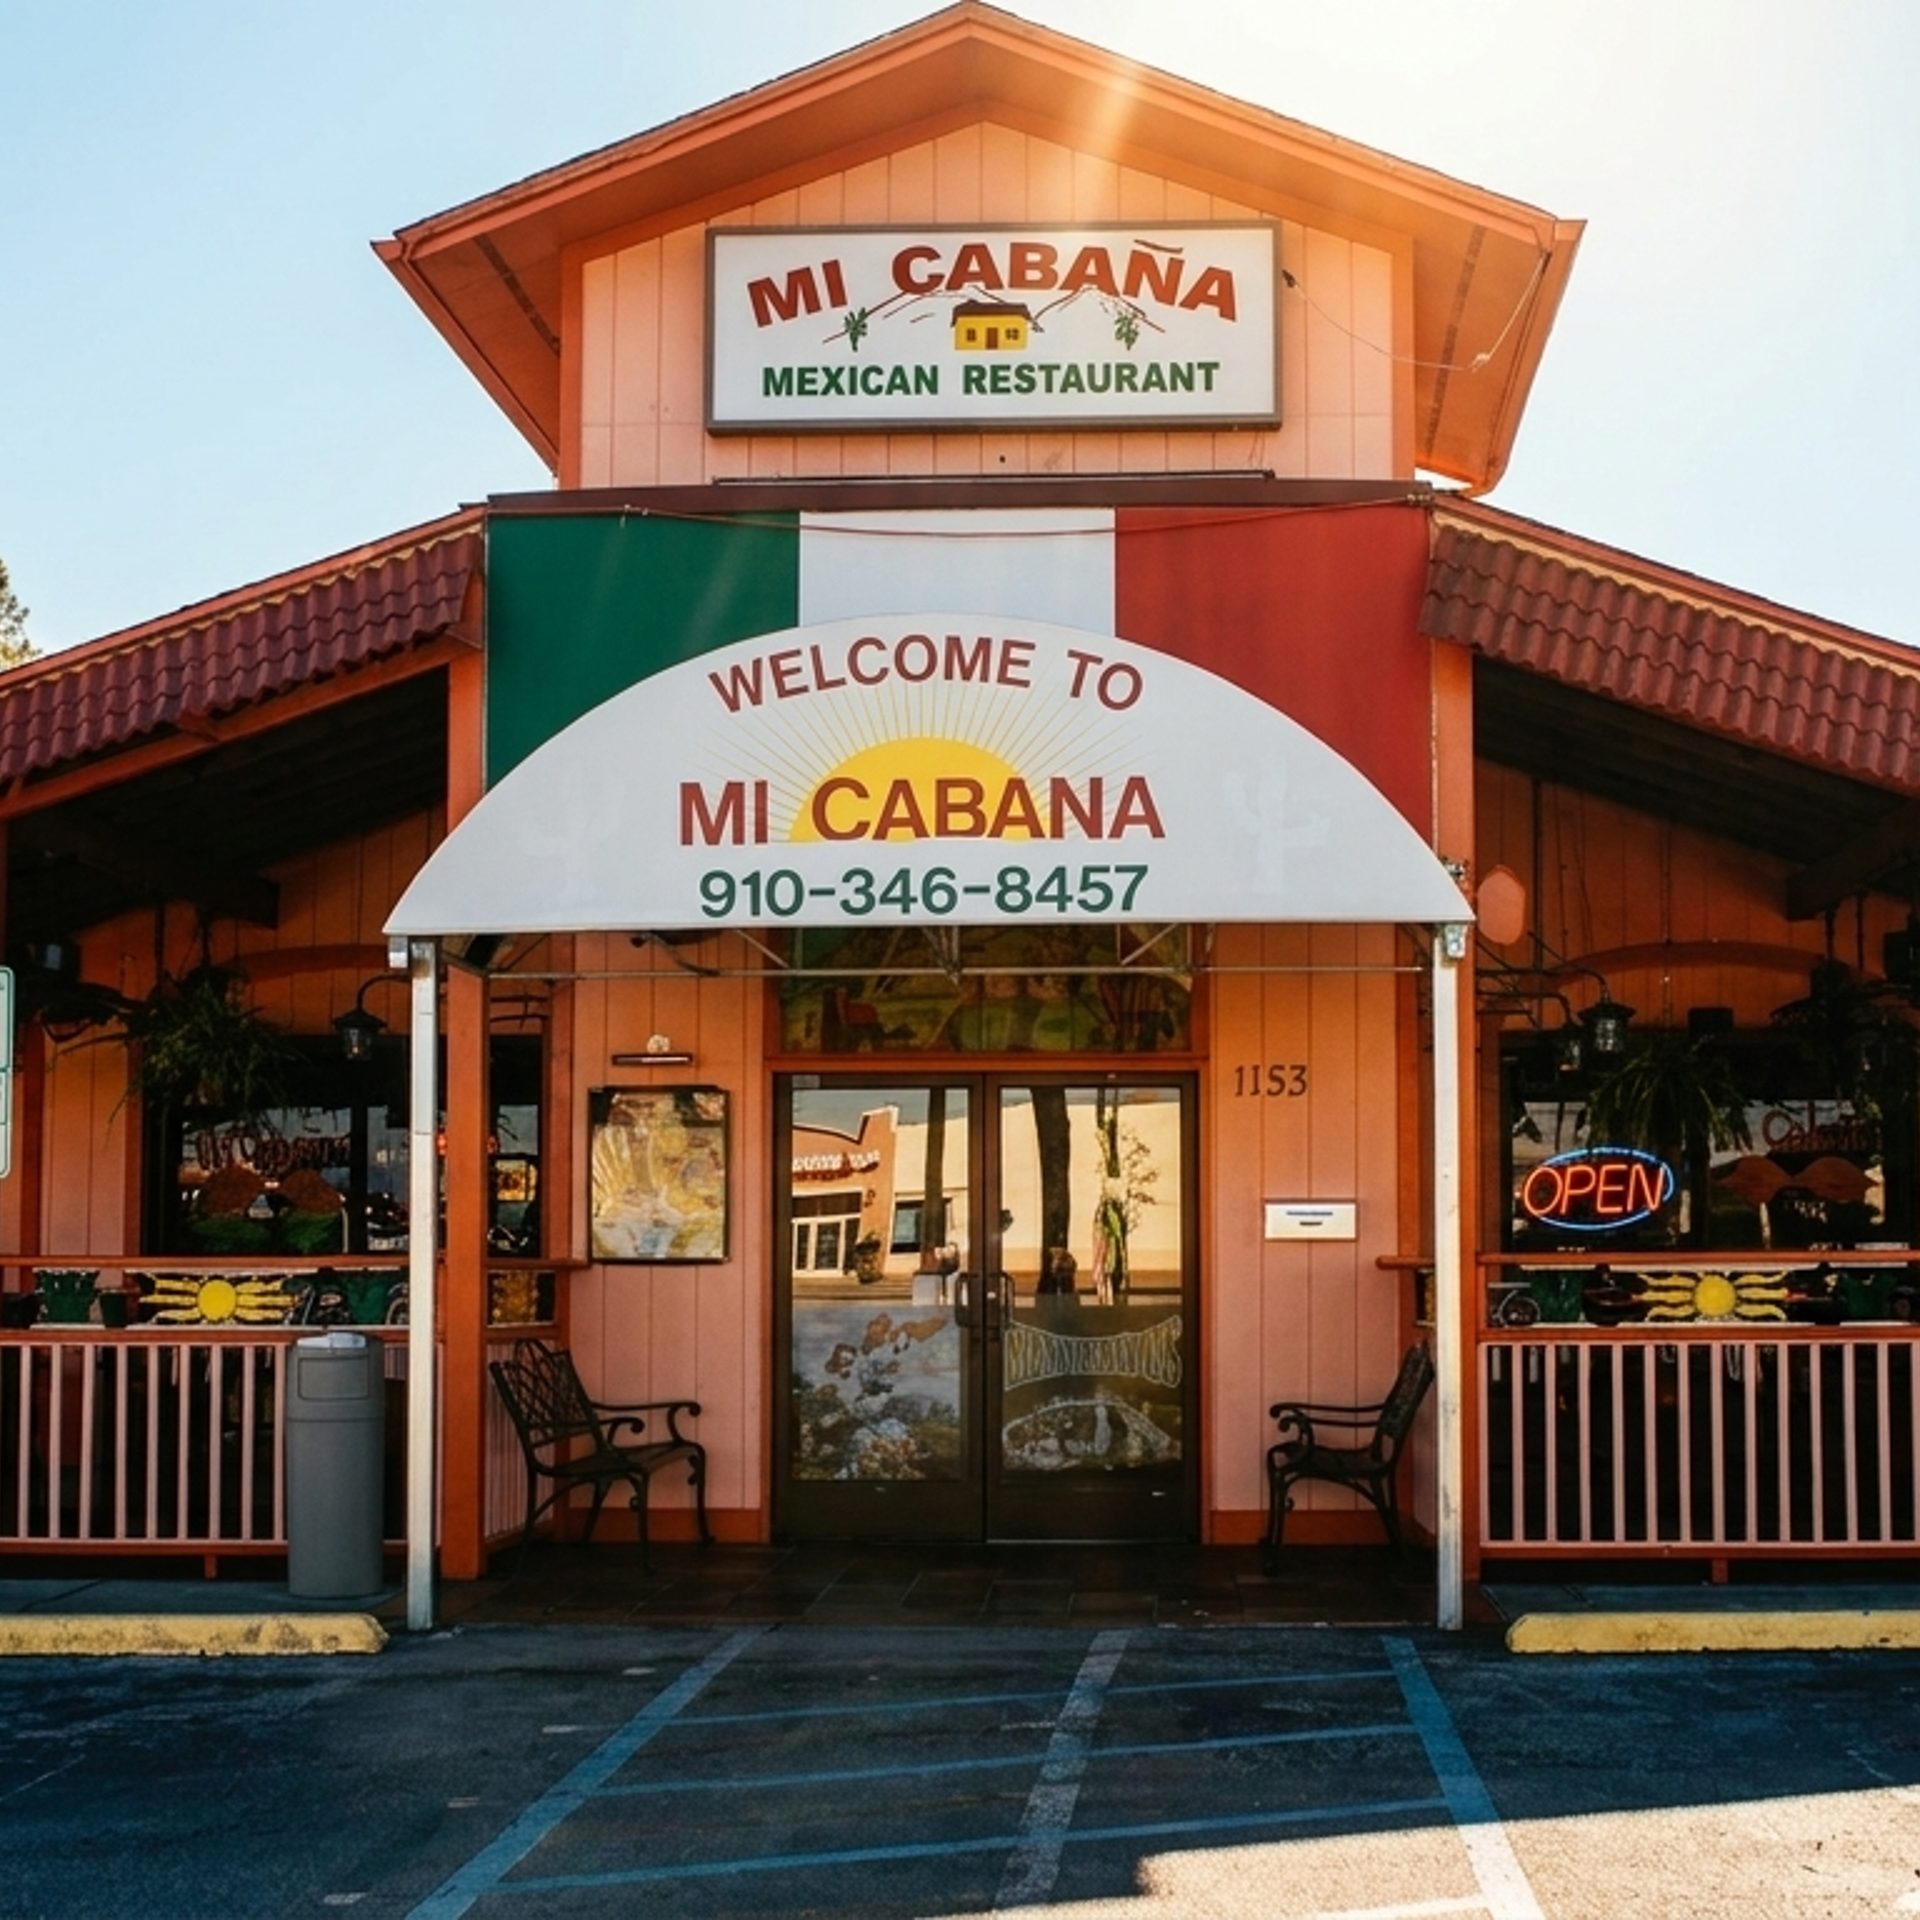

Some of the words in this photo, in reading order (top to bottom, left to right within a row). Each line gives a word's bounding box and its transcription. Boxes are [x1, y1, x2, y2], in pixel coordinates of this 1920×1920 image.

[748, 259, 847, 327] MI
[892, 239, 1237, 321] CABAÑA
[763, 365, 938, 396] MEXICAN
[963, 362, 1219, 394] RESTAURANT
[708, 634, 1035, 712] WELCOME
[1066, 649, 1143, 711] TO
[680, 781, 767, 845] MI
[811, 776, 1165, 841] CABANA
[700, 864, 1149, 918] 910-346-8457
[1524, 1162, 1665, 1215] OPEN
